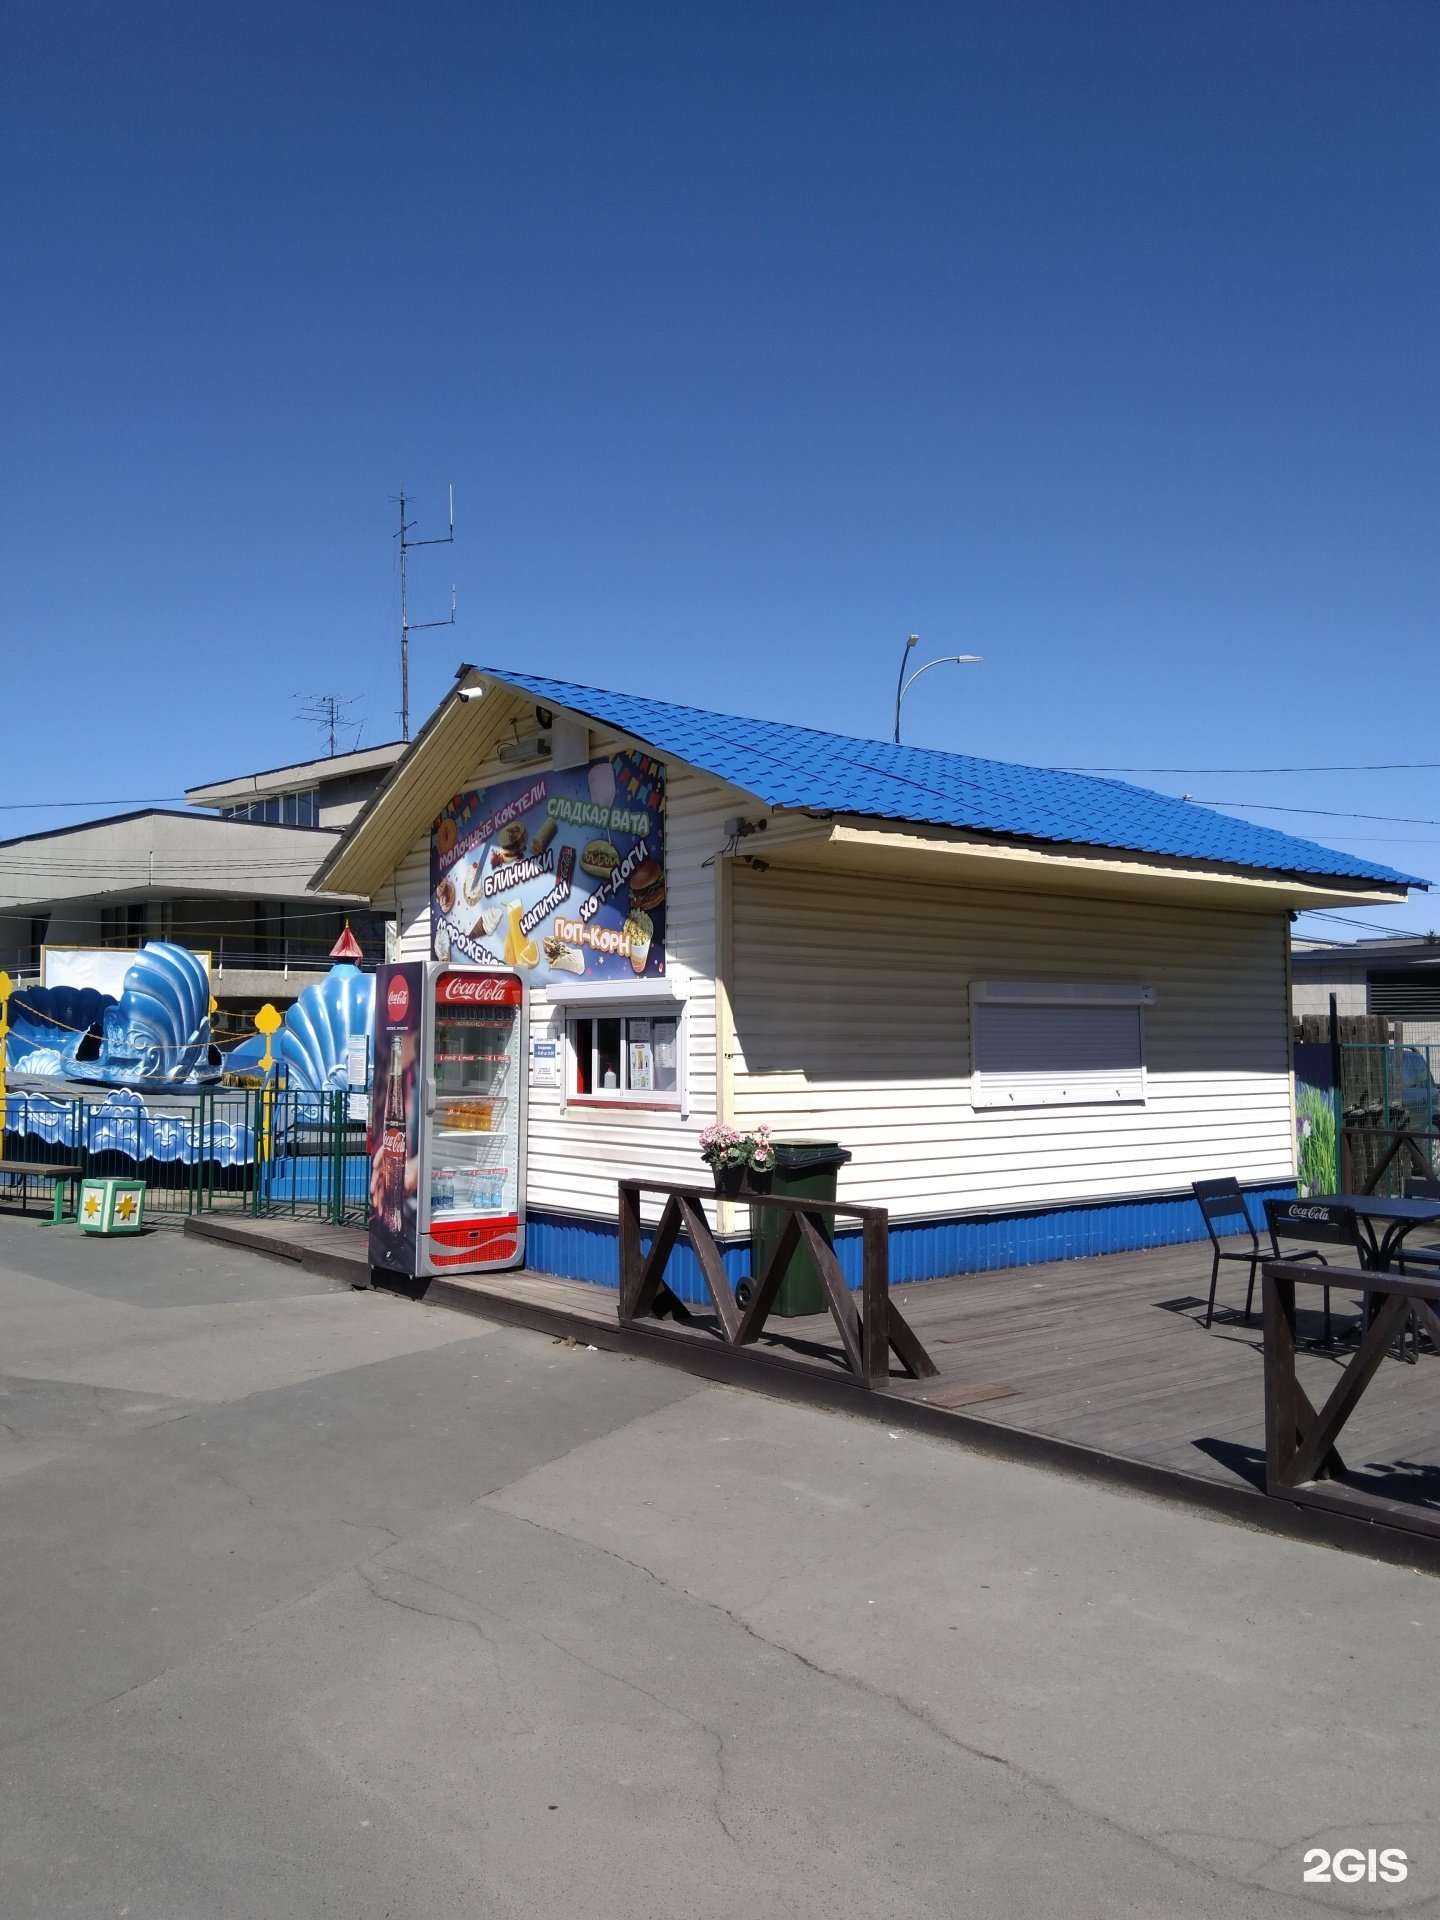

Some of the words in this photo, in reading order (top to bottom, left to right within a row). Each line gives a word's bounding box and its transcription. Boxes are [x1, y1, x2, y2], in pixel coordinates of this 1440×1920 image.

[494, 780, 548, 829] КОКТЕЛИ
[546, 797, 609, 828] СЛАДКАЯ
[610, 808, 650, 835] ВАТА
[483, 848, 554, 897] БЛИНЧИКИ
[579, 839, 649, 922] ХОТ-ДОГИ
[519, 881, 570, 935] НАПИТКИ
[553, 918, 632, 956] ПОП-КОРН
[445, 977, 510, 1001] Coca-Cola
[1288, 1204, 1330, 1220] Coca-Cola
